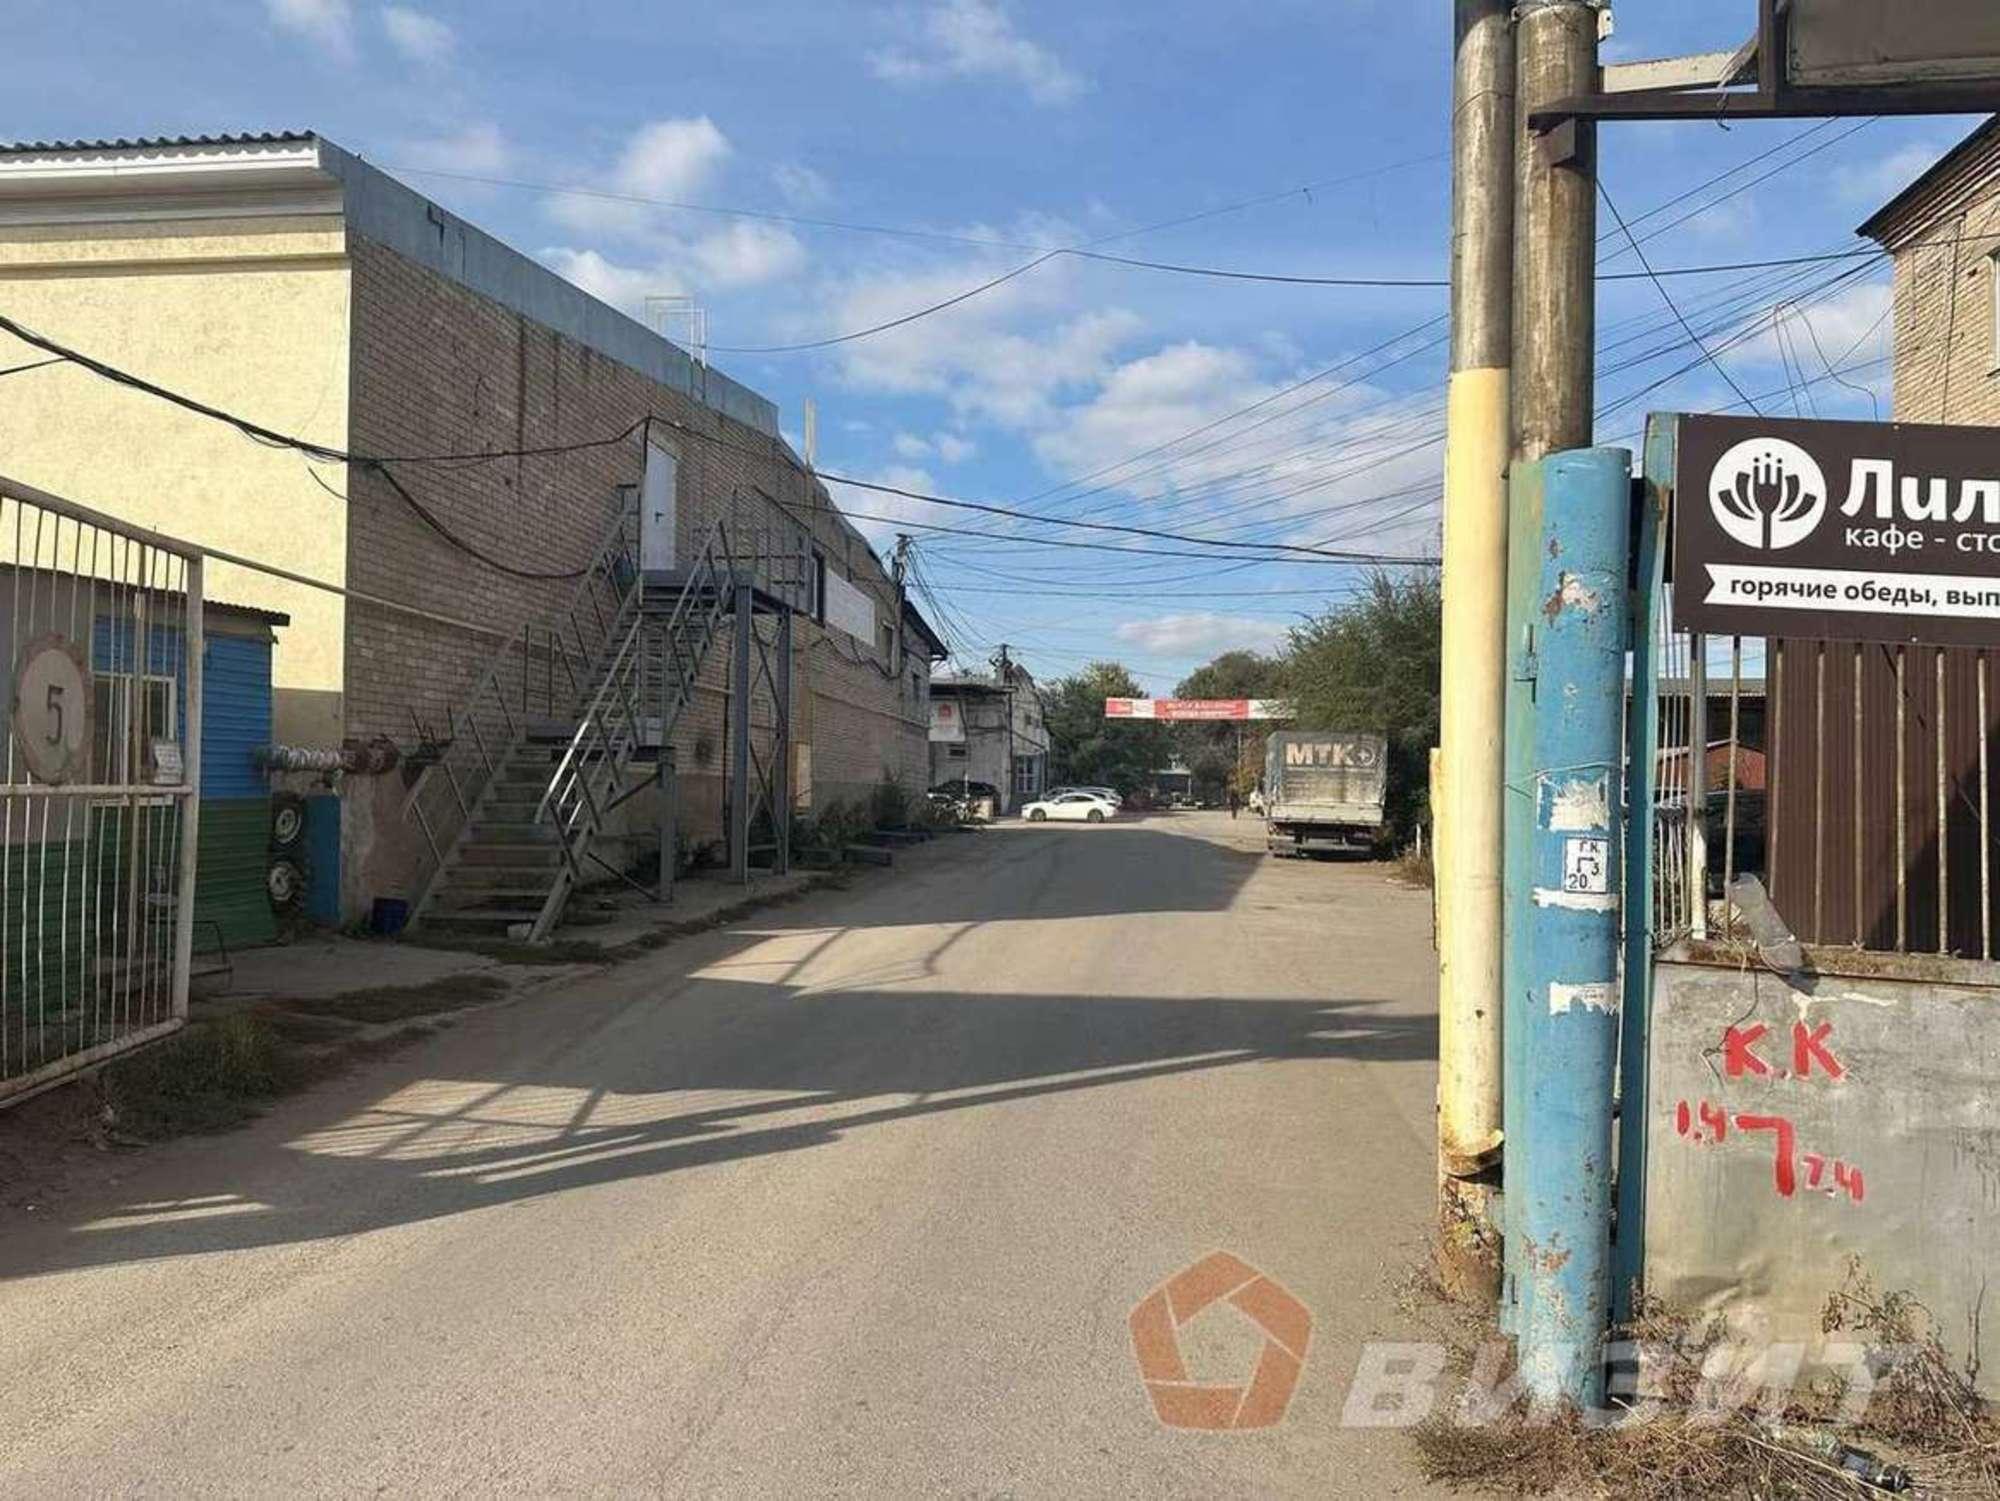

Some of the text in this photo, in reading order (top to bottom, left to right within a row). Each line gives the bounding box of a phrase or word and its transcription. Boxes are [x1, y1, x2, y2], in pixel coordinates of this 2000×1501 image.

[1840, 458, 2000, 523] Лил
[1845, 523, 1924, 556] кафе
[1730, 578, 2000, 607] горячие обеды, вып
[46, 684, 64, 745] 5
